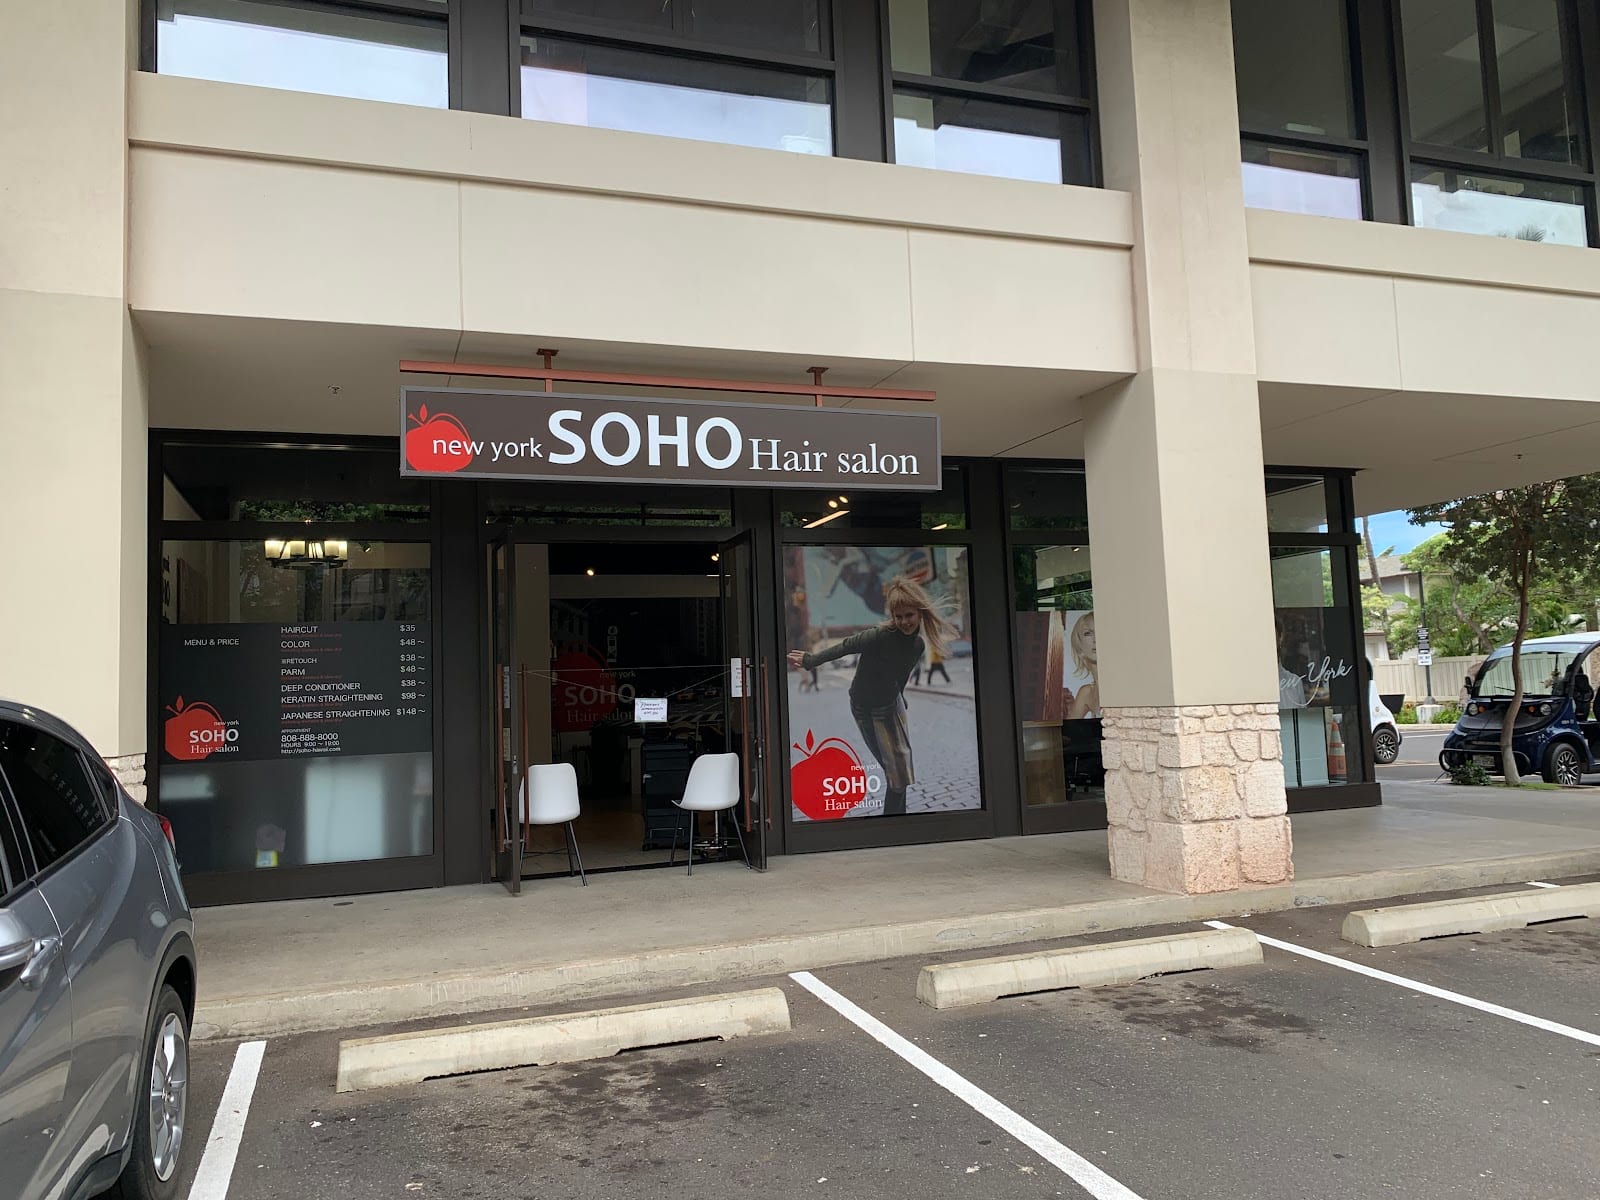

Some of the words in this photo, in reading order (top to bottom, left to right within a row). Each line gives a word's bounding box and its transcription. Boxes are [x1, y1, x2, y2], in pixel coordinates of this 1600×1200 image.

[432, 435, 483, 456] new
[490, 437, 543, 464] york
[548, 409, 742, 470] SOHO
[748, 438, 828, 474] Hair
[837, 443, 920, 475] salon
[281, 625, 319, 634] HAIRCUT
[400, 624, 416, 632] $35
[217, 638, 240, 646] PRICE
[280, 640, 311, 649] COLOR
[281, 668, 306, 676] PARM
[281, 684, 303, 693] DEEP
[304, 682, 361, 692] CONDITIONER
[281, 695, 316, 704] KERATIN
[318, 693, 384, 703] STRAIGHTENING
[565, 683, 636, 706] SOHO
[281, 711, 324, 721] JAPANESE
[325, 708, 391, 719] STRAIGHTENING
[226, 719, 240, 727] york
[189, 728, 239, 744] SOHO
[190, 744, 213, 754] Hair
[214, 743, 240, 753] salon
[822, 774, 881, 797] SOHO
[824, 798, 852, 811] Hair
[853, 797, 883, 809] salon
